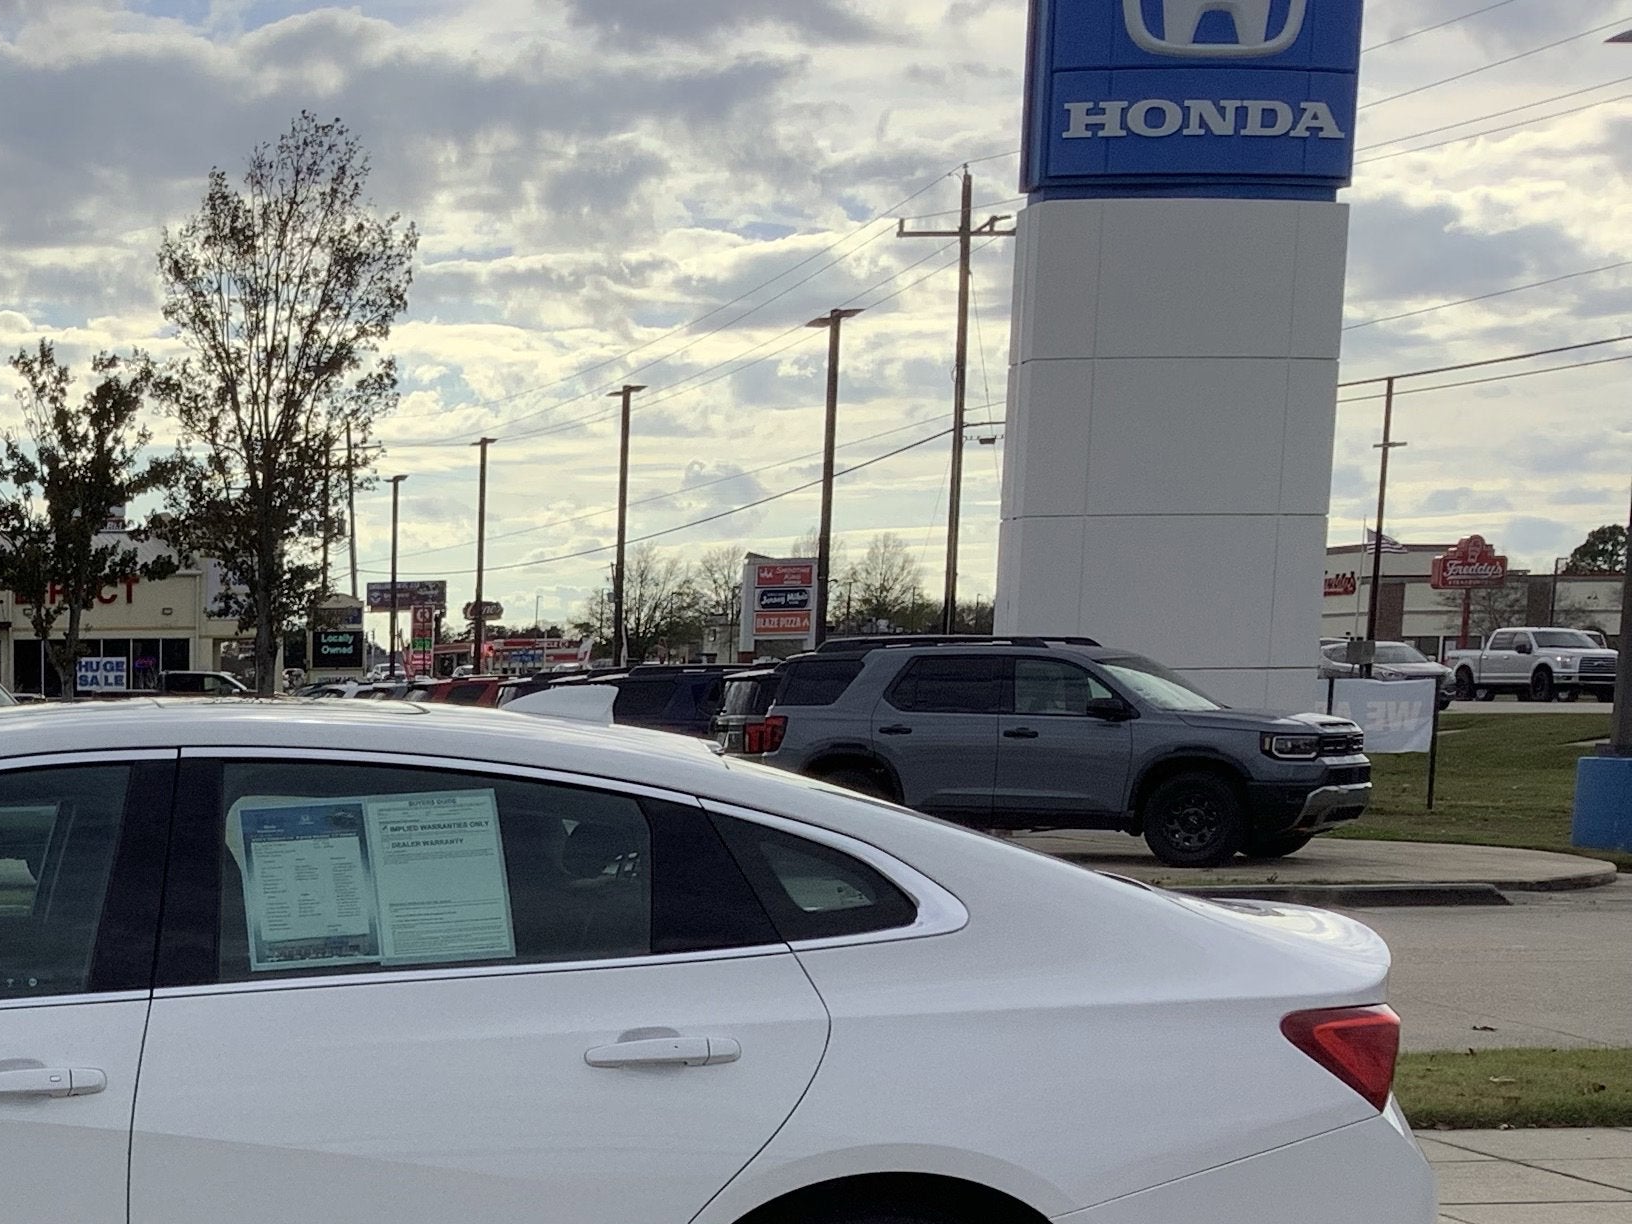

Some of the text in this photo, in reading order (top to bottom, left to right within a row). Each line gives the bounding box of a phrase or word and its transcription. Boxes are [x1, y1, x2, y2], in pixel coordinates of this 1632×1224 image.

[1062, 99, 1345, 139] HONDA
[1443, 560, 1504, 578] Freddy's
[756, 617, 801, 628] BLAZE PIZZA
[321, 634, 353, 644] Locally
[321, 645, 353, 654] Owned
[78, 660, 125, 673] HUGE
[78, 674, 125, 687] SALE
[420, 823, 468, 831] WARRANTIES
[469, 820, 490, 828] ONLY
[391, 838, 464, 849] DEALER WARRANTY
